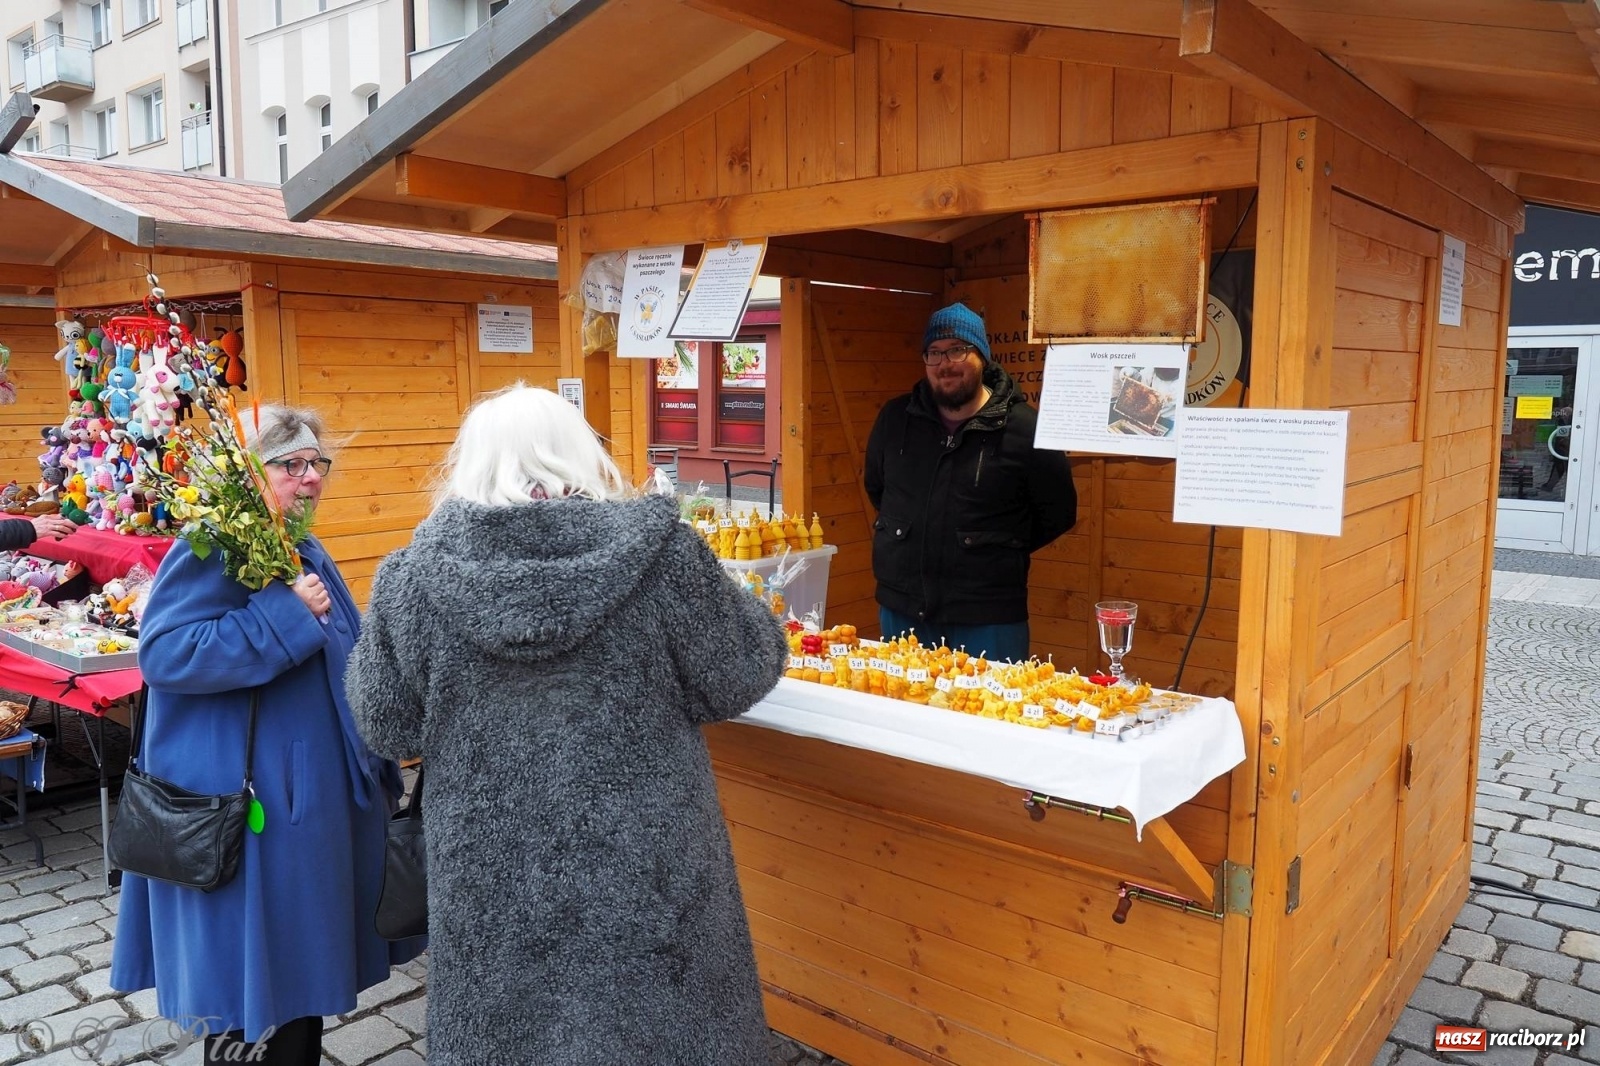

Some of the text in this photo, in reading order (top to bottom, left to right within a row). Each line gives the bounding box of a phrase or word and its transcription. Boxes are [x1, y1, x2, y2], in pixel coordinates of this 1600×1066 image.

[655, 253, 672, 261] ręcznie
[632, 262, 656, 270] wykonane
[1109, 352, 1137, 360] pszczeli
[680, 401, 697, 410] ŚWIATA
[1261, 416, 1278, 424] świec
[1303, 418, 1339, 427] pszczelego:
